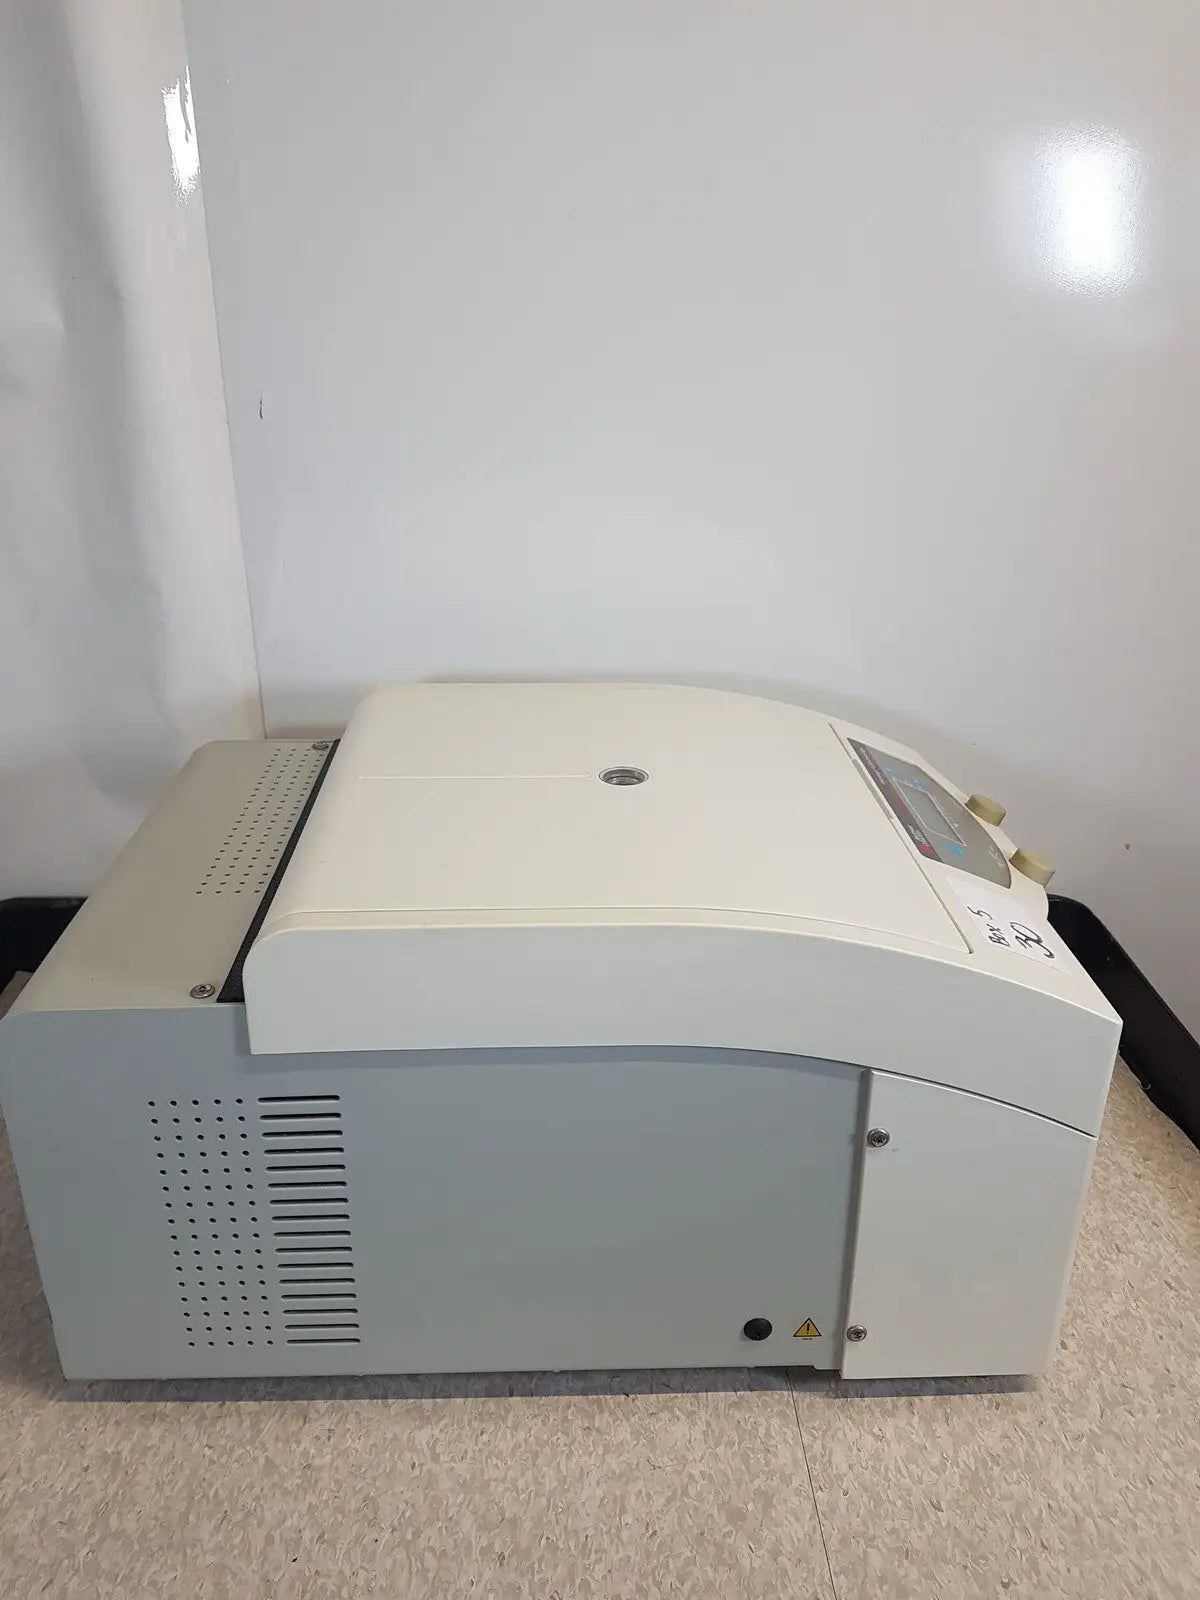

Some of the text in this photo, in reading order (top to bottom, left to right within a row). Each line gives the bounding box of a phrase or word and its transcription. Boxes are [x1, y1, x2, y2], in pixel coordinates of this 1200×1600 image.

[967, 906, 1011, 948] Box 5
[1010, 921, 1055, 959] 30
